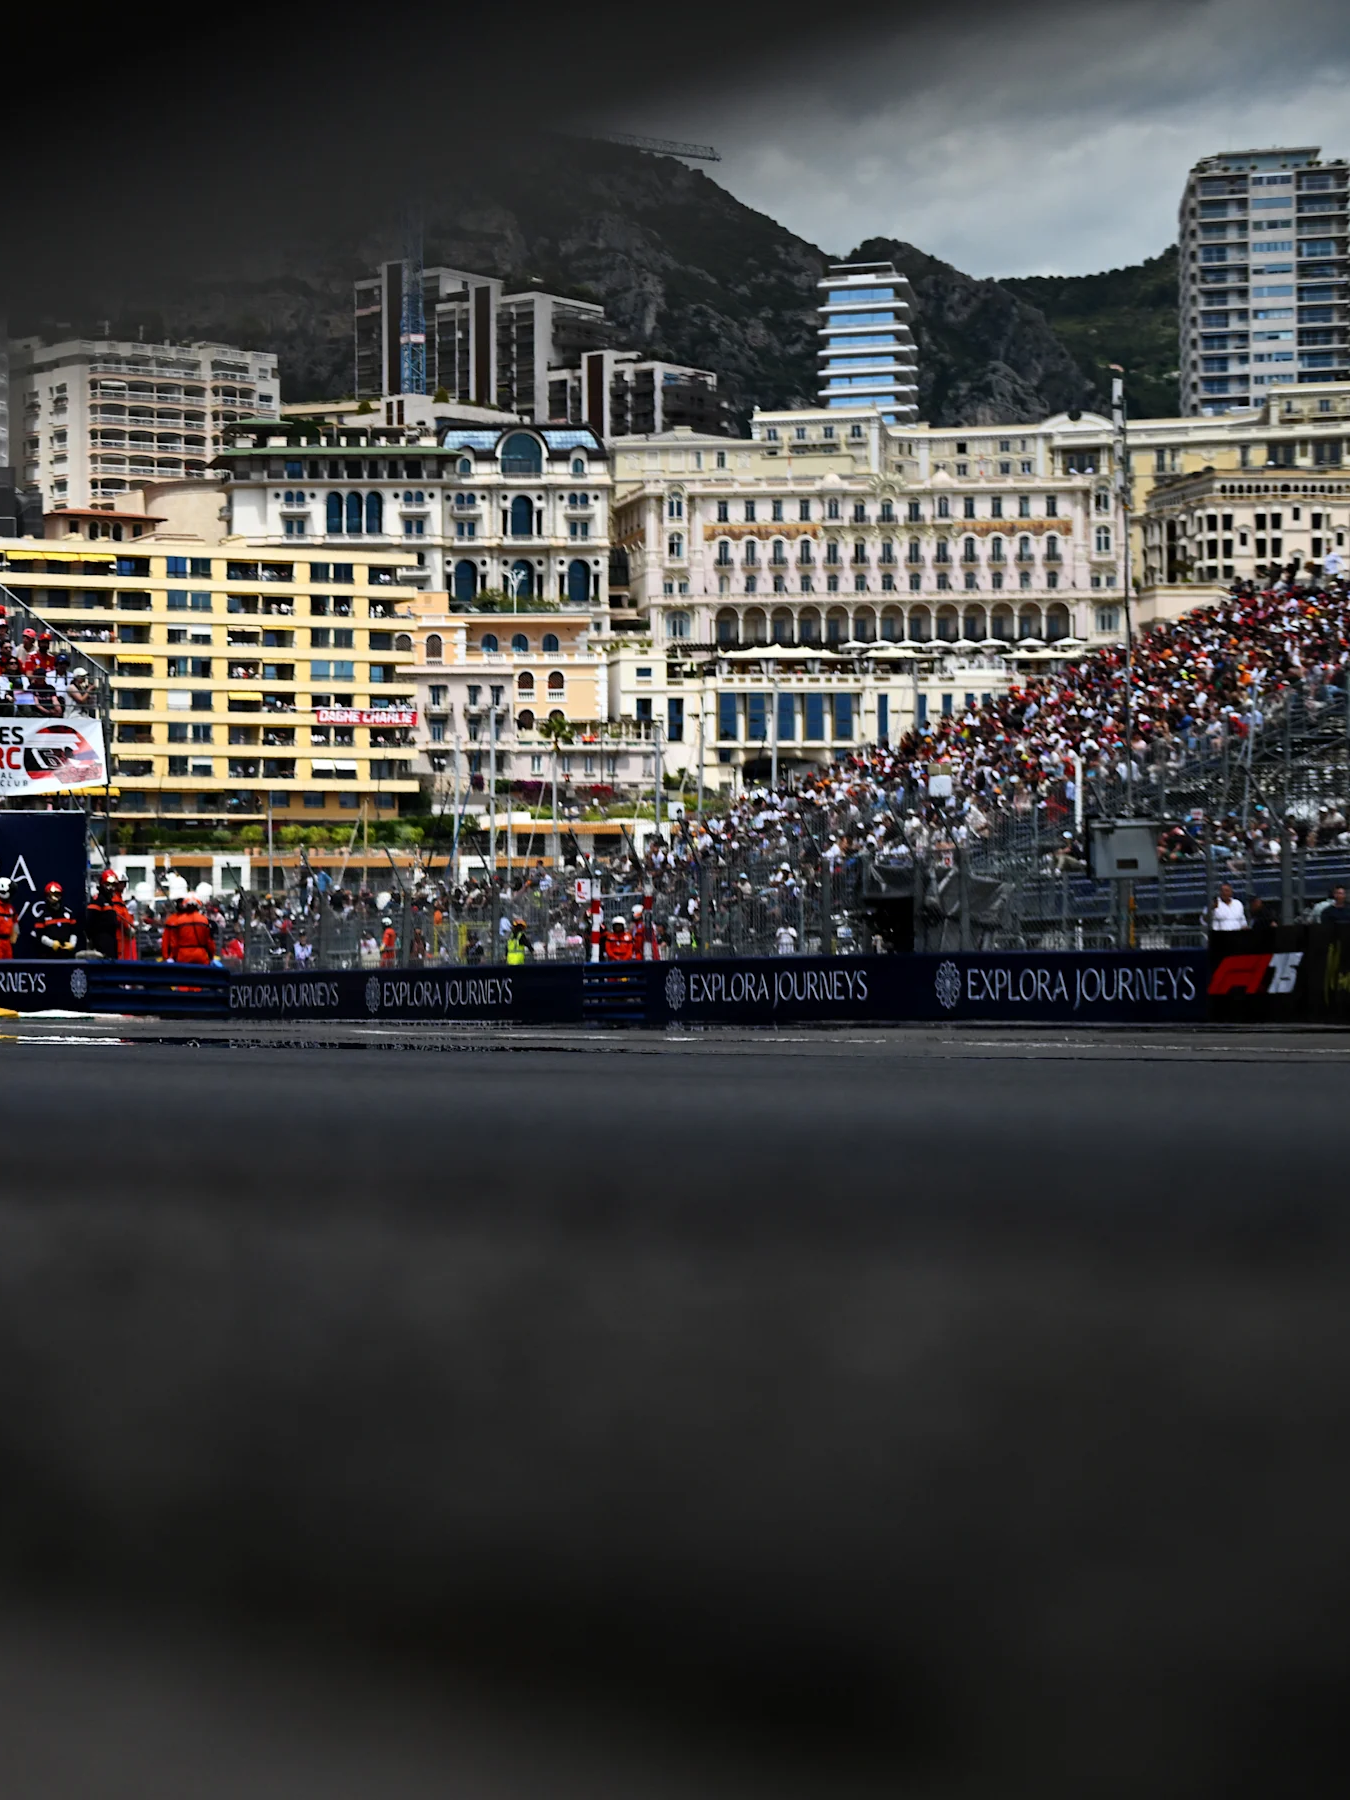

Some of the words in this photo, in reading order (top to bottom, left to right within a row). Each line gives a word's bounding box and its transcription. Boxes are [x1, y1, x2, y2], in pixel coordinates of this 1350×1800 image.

[0, 779, 29, 787] CLUB
[229, 983, 279, 1009] EXPLORA
[280, 981, 339, 1013] JOURNEYS
[383, 980, 442, 1008] EXPLORA
[444, 977, 513, 1012] JOURNEYS
[689, 972, 770, 1003] EXPLORA
[772, 969, 868, 1010] JOURNEYS
[966, 968, 1069, 1002] EXPLORA
[1072, 966, 1196, 1011] JOURNEYS
